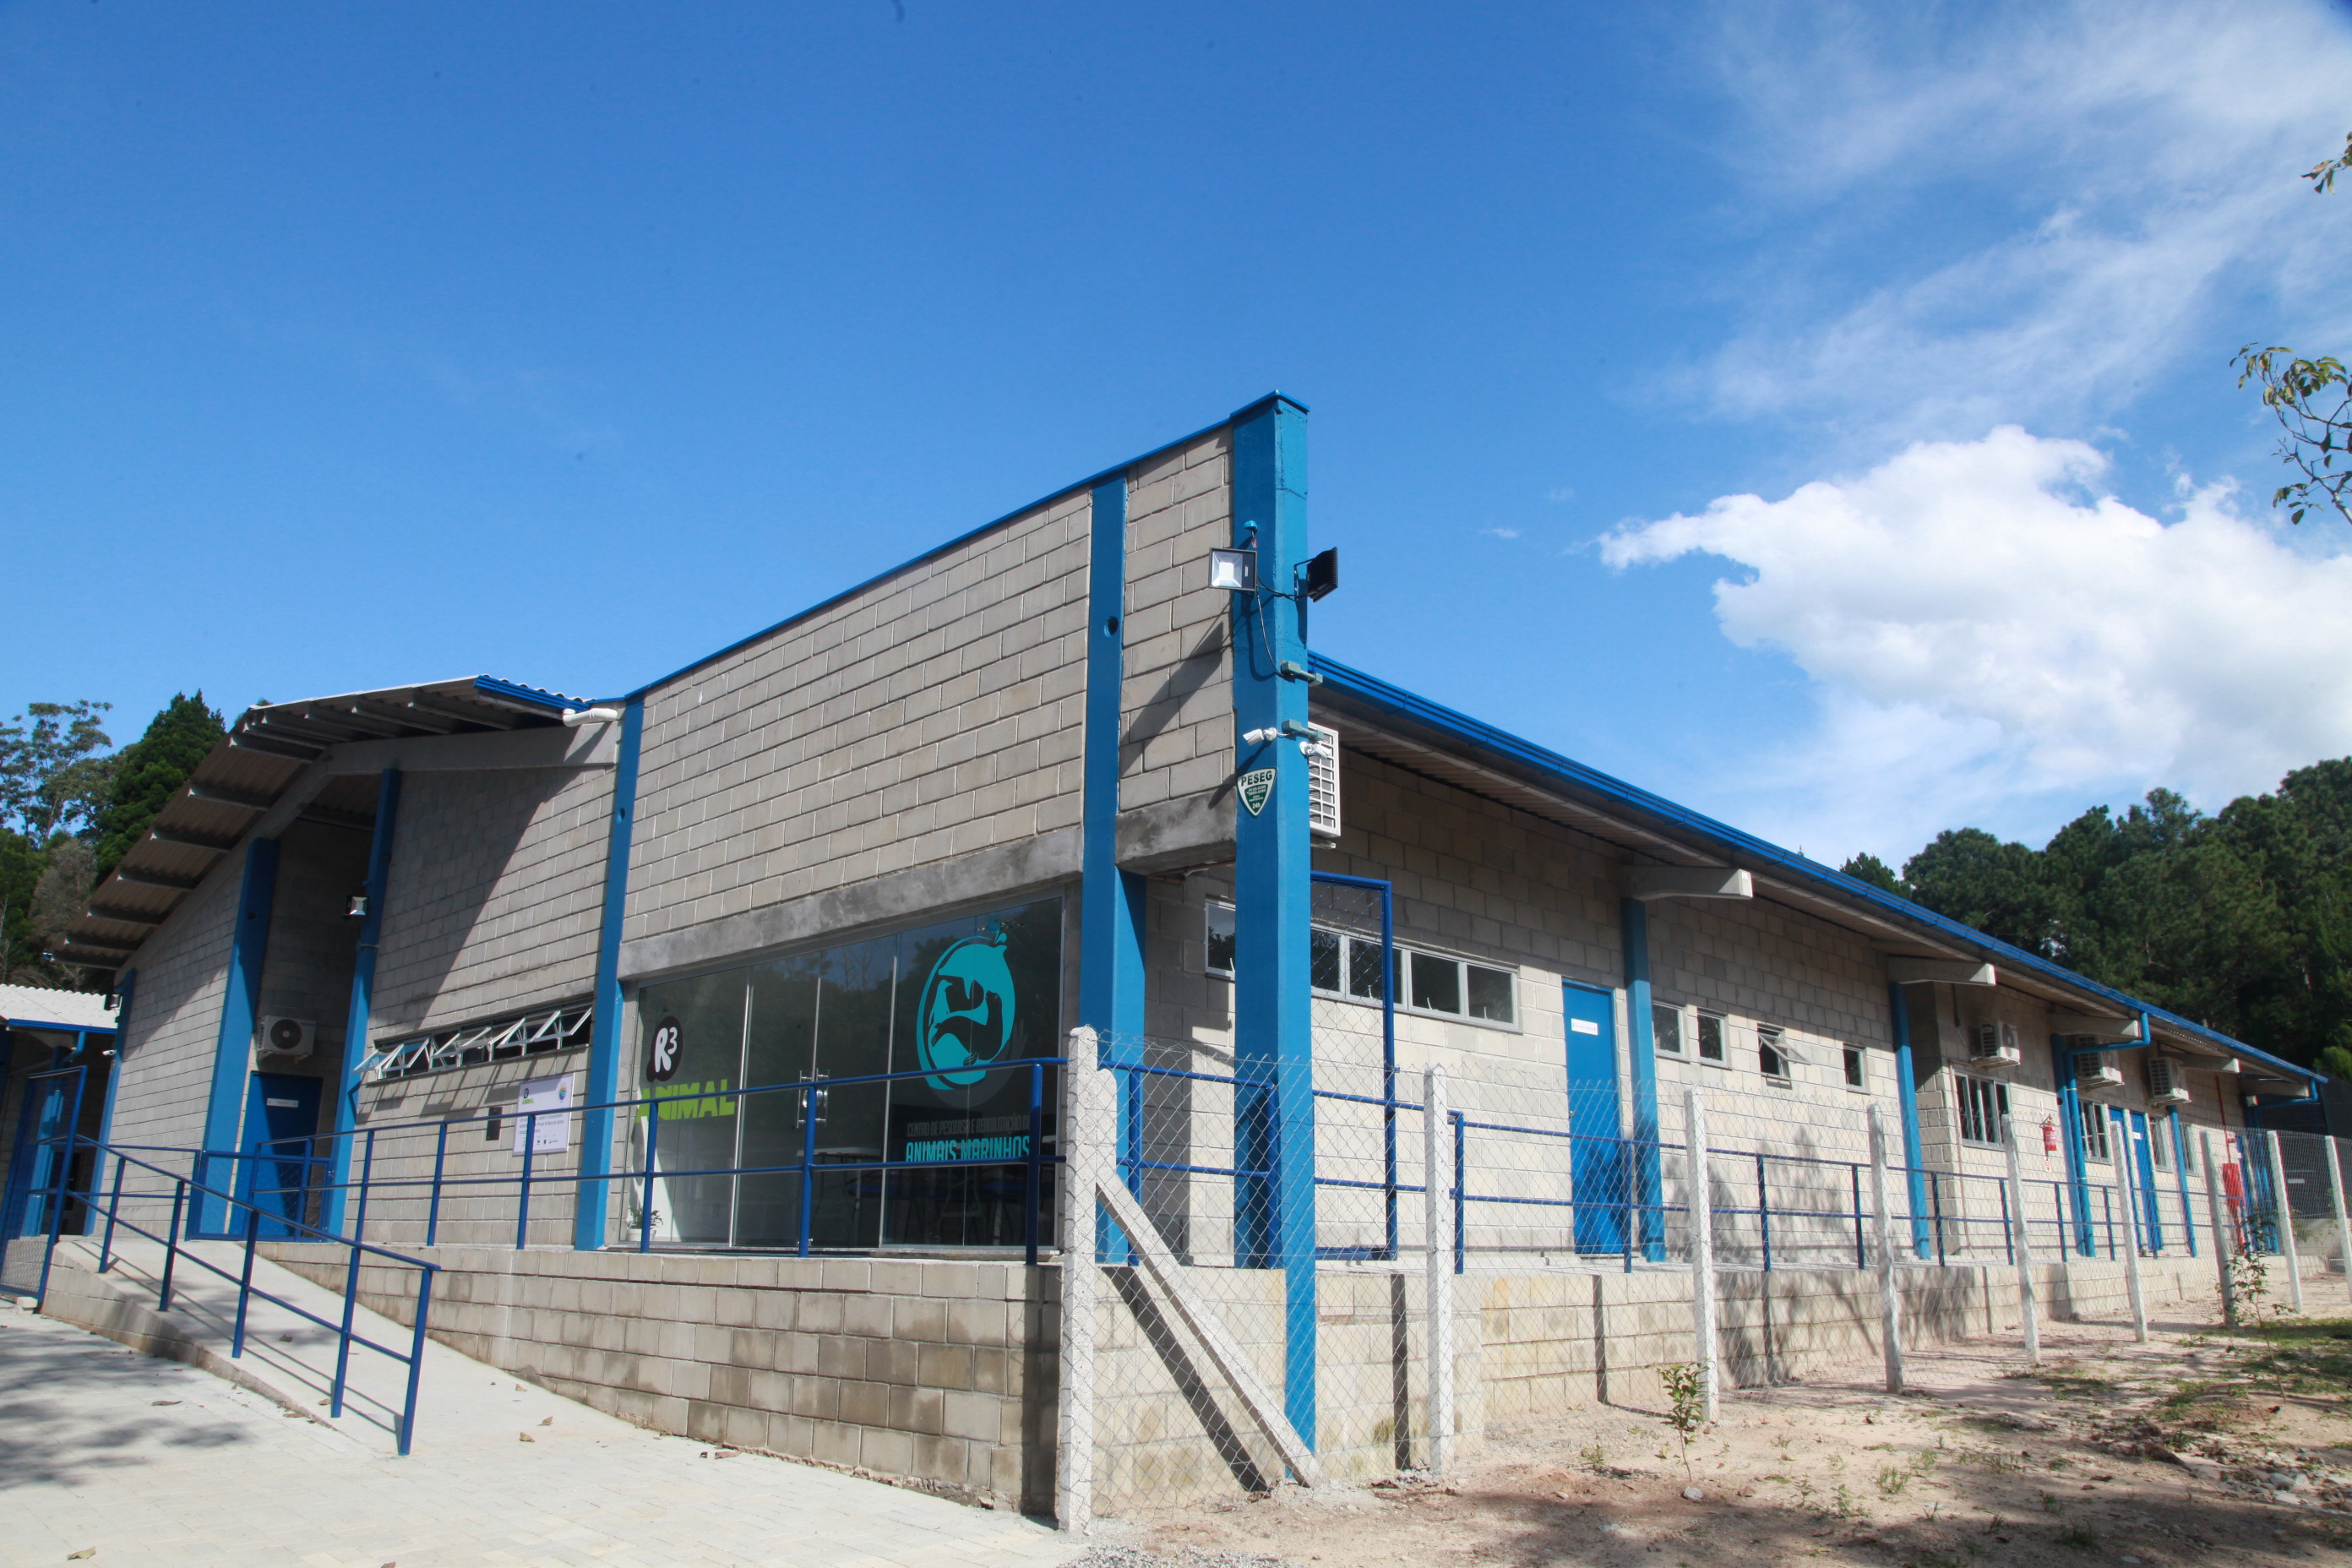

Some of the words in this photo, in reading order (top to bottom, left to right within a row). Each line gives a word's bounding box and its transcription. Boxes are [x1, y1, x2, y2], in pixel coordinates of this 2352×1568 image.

[1241, 770, 1272, 787] PESEG
[635, 1079, 735, 1124] ANIMAL
[907, 1121, 930, 1137] CENTRO
[930, 1120, 939, 1136] DE
[939, 1119, 970, 1135] PESQUISA
[971, 1118, 976, 1134] E
[906, 1140, 956, 1162] ANIMAIS
[961, 1135, 1030, 1159] MARINHOS
